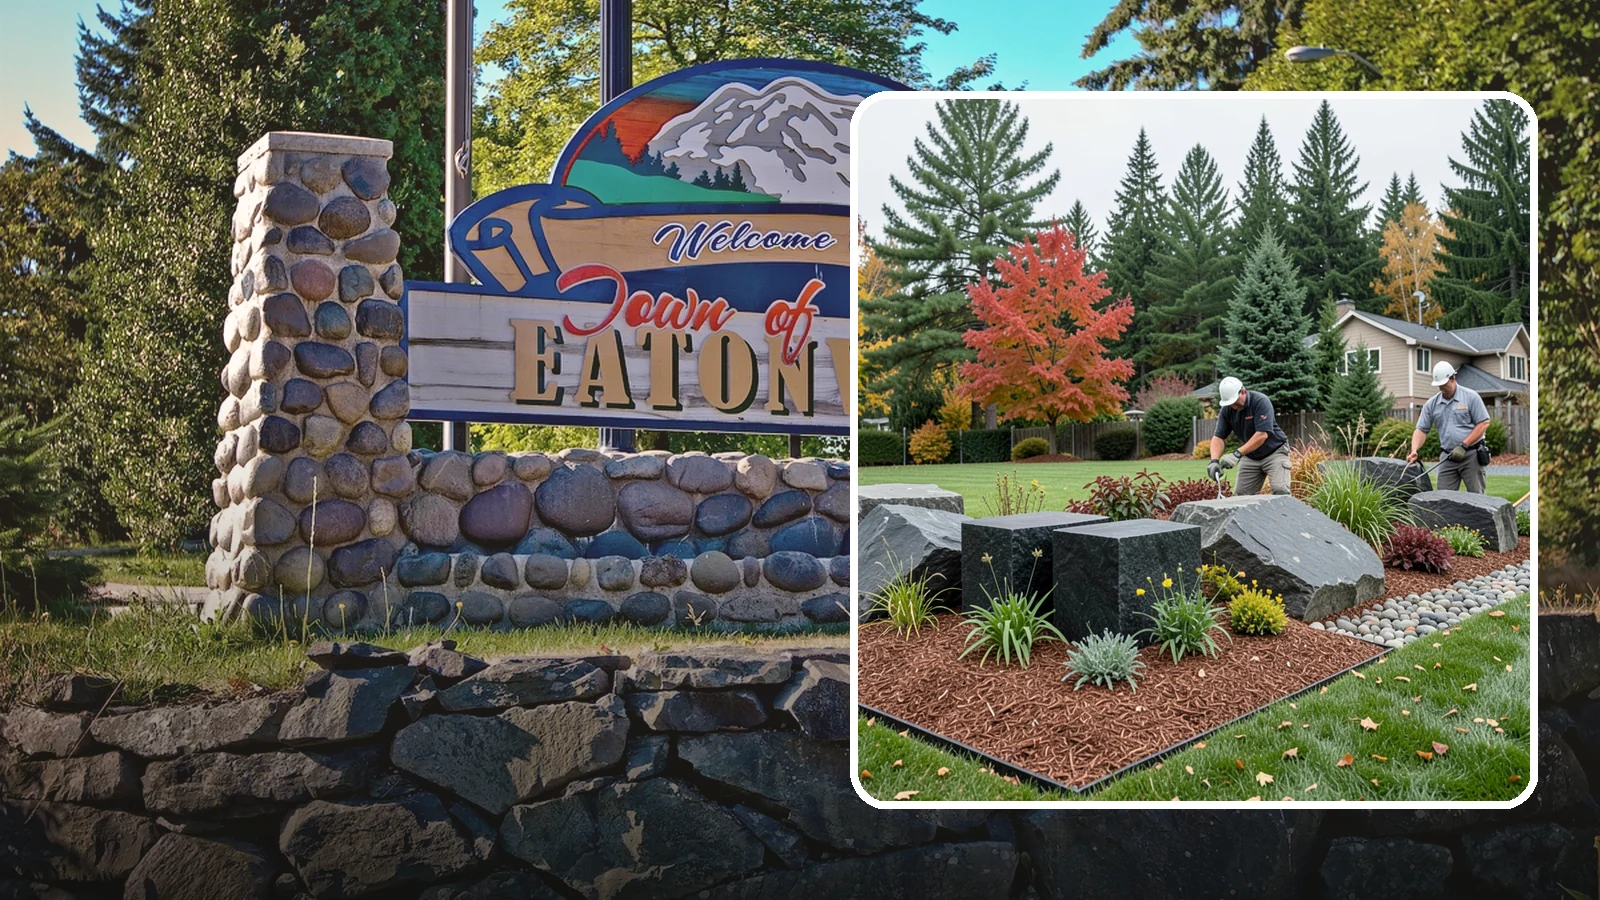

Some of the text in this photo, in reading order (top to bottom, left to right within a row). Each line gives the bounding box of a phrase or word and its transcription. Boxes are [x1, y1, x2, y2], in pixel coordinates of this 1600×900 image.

[653, 221, 837, 263] Welcome
[556, 263, 826, 366] Town of
